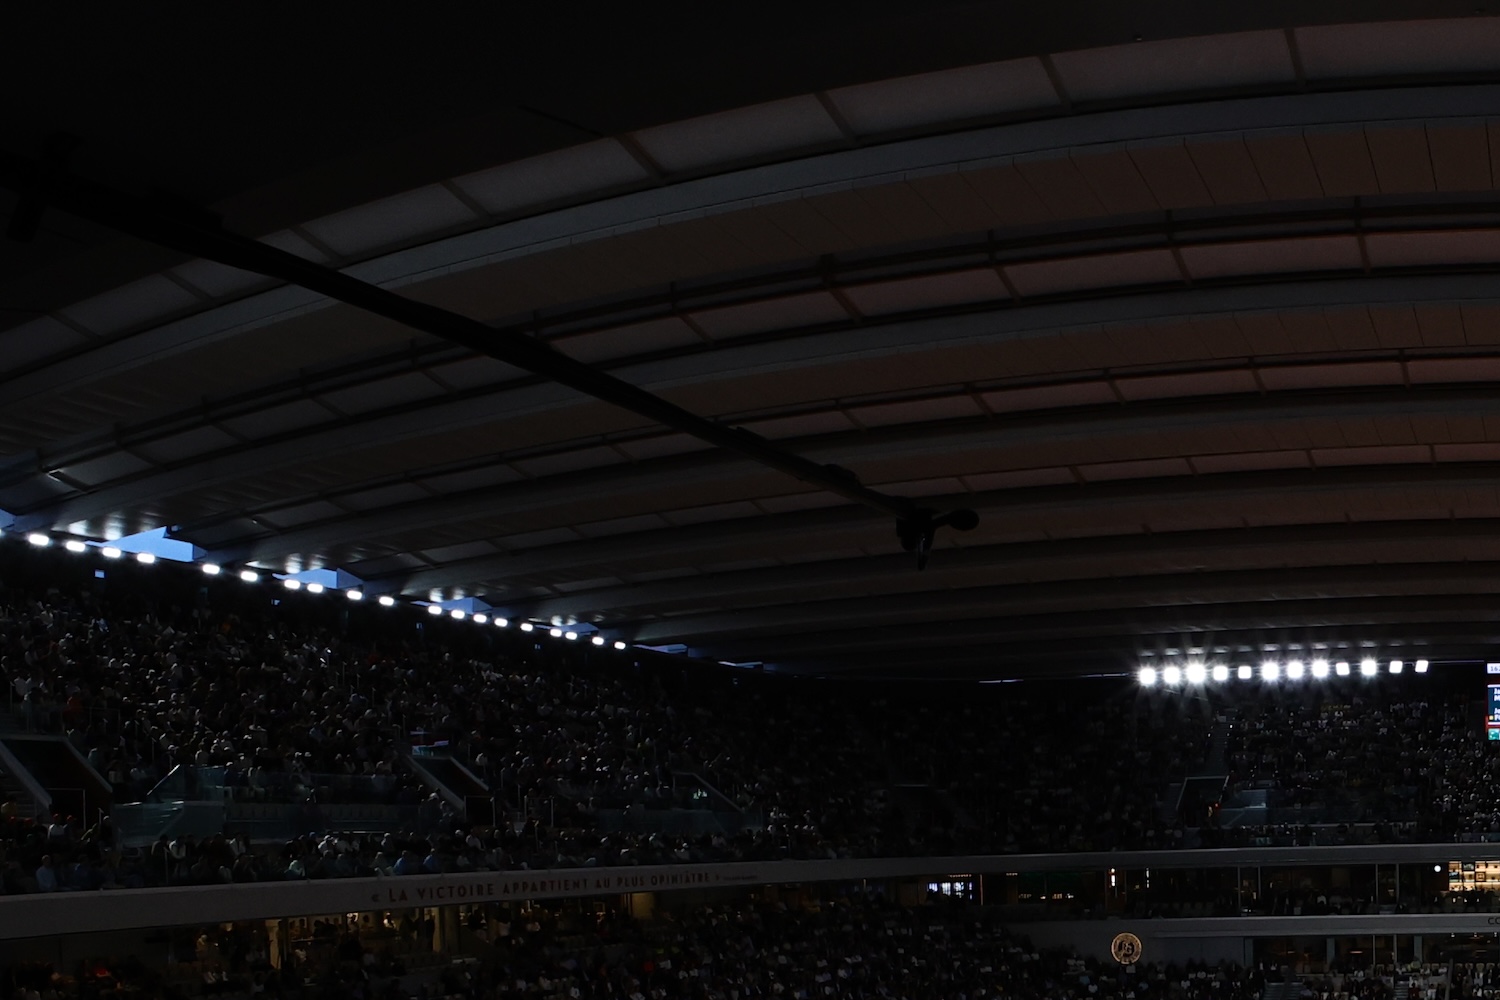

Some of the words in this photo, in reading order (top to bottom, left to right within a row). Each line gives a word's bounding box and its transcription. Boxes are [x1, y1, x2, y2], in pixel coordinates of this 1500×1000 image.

[389, 888, 408, 902] LA
[417, 883, 494, 900] VICTOIRE
[503, 878, 588, 895] APPARTIENT
[596, 877, 610, 890] AU
[617, 875, 645, 888] PLUS
